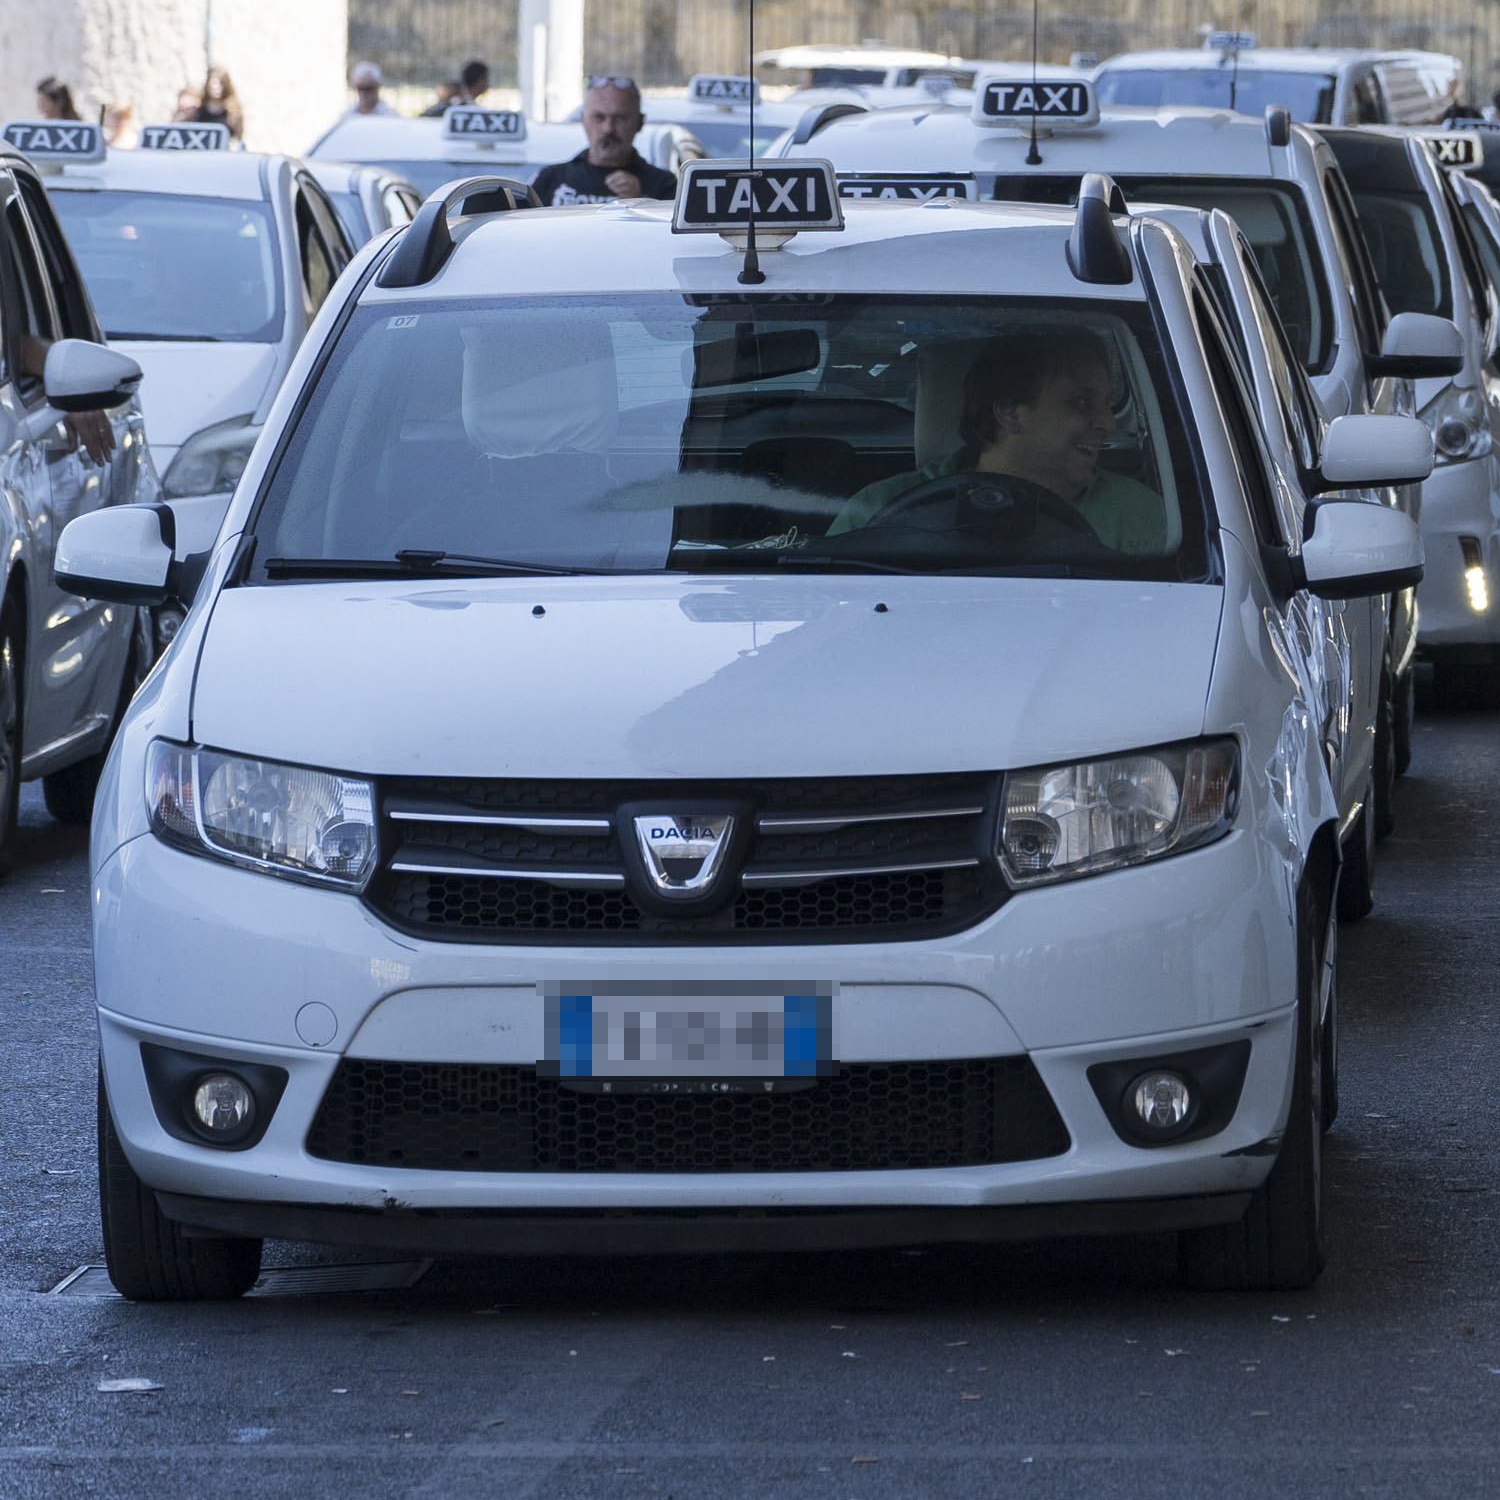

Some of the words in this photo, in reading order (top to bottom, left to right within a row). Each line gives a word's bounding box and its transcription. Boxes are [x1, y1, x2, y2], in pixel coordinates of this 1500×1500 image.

[990, 86, 1080, 112] TAXI
[452, 114, 517, 133] TAXI
[8, 127, 91, 149] TAXI
[146, 129, 217, 149] TAXI
[696, 177, 816, 213] TAXI
[395, 316, 416, 327] 07
[651, 827, 716, 840] DACIA
